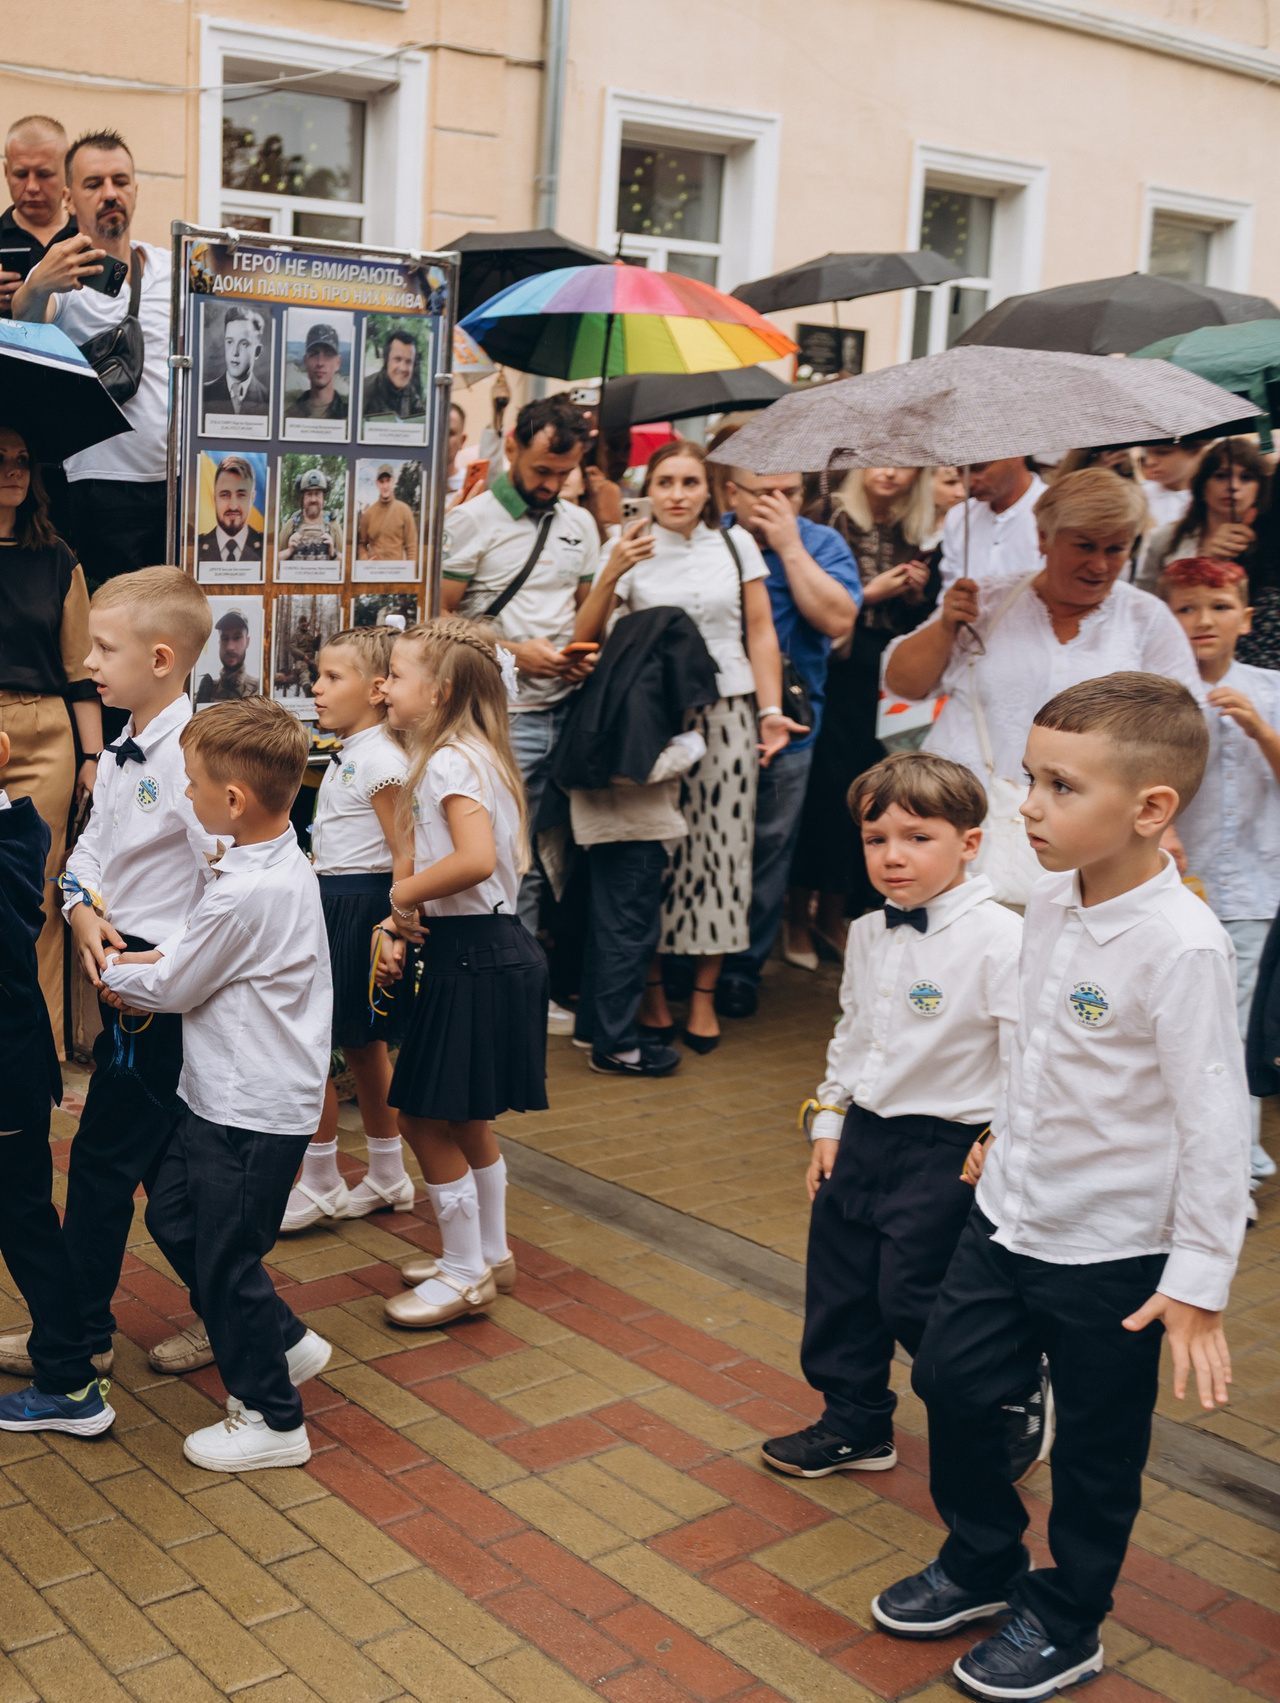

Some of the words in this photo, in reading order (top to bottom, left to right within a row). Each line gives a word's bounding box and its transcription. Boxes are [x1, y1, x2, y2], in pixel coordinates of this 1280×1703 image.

[233, 252, 281, 274] ГЕРОЇ
[285, 259, 308, 276] НЕ
[311, 261, 408, 289] ВМИРАЮТЬ,
[212, 274, 254, 294] ДОКИ
[257, 279, 319, 300] ПАМ'ЯТЬ
[322, 285, 350, 303] ПРО
[353, 289, 381, 307] НИХ
[383, 292, 424, 310] ЖИВА
